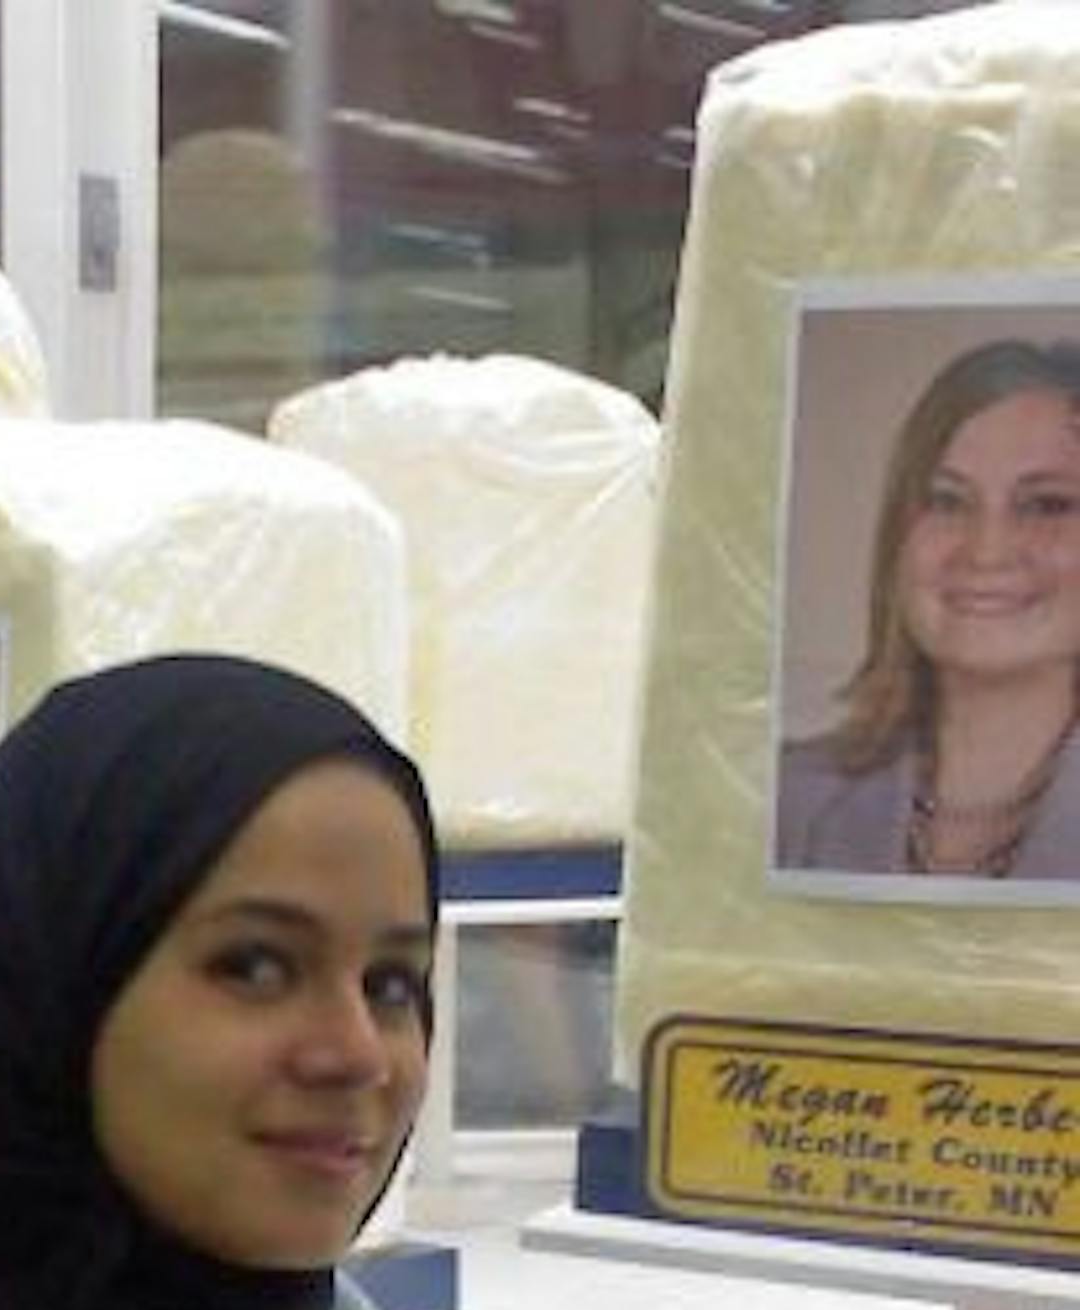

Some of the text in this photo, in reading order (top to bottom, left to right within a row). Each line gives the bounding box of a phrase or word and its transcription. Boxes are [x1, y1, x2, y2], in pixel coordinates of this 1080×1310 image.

[712, 1058, 889, 1126] Megan
[751, 1120, 1080, 1188] Nicollet County
[769, 1162, 1060, 1216] St. Peter, MN
